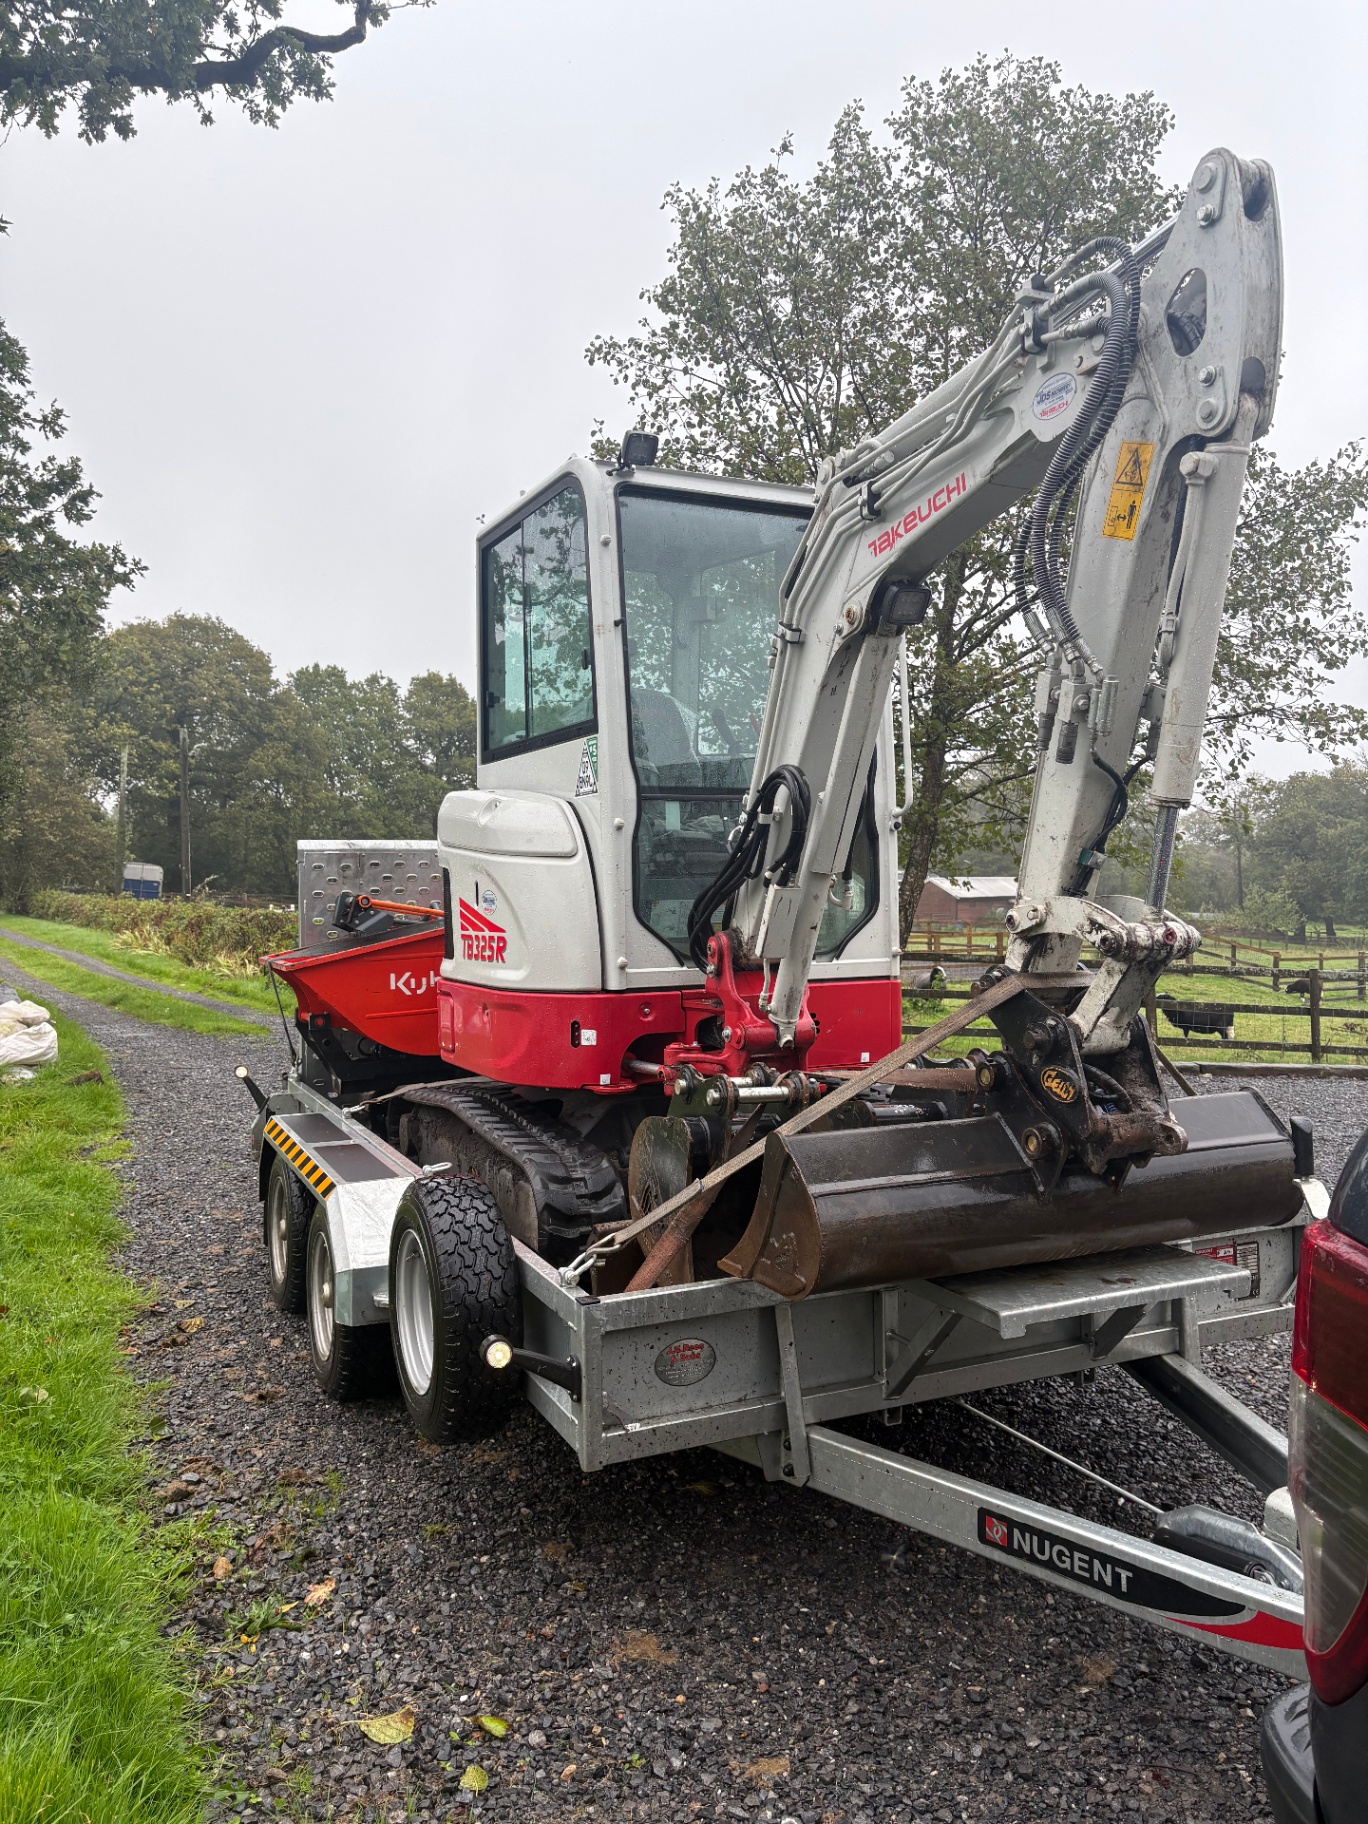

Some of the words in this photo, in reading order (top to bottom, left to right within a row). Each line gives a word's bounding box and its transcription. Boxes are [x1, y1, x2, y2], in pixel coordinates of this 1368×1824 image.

[868, 472, 967, 558] TAKEUCHI
[461, 934, 507, 964] TB325R
[1013, 1527, 1133, 1593] NUGENT
